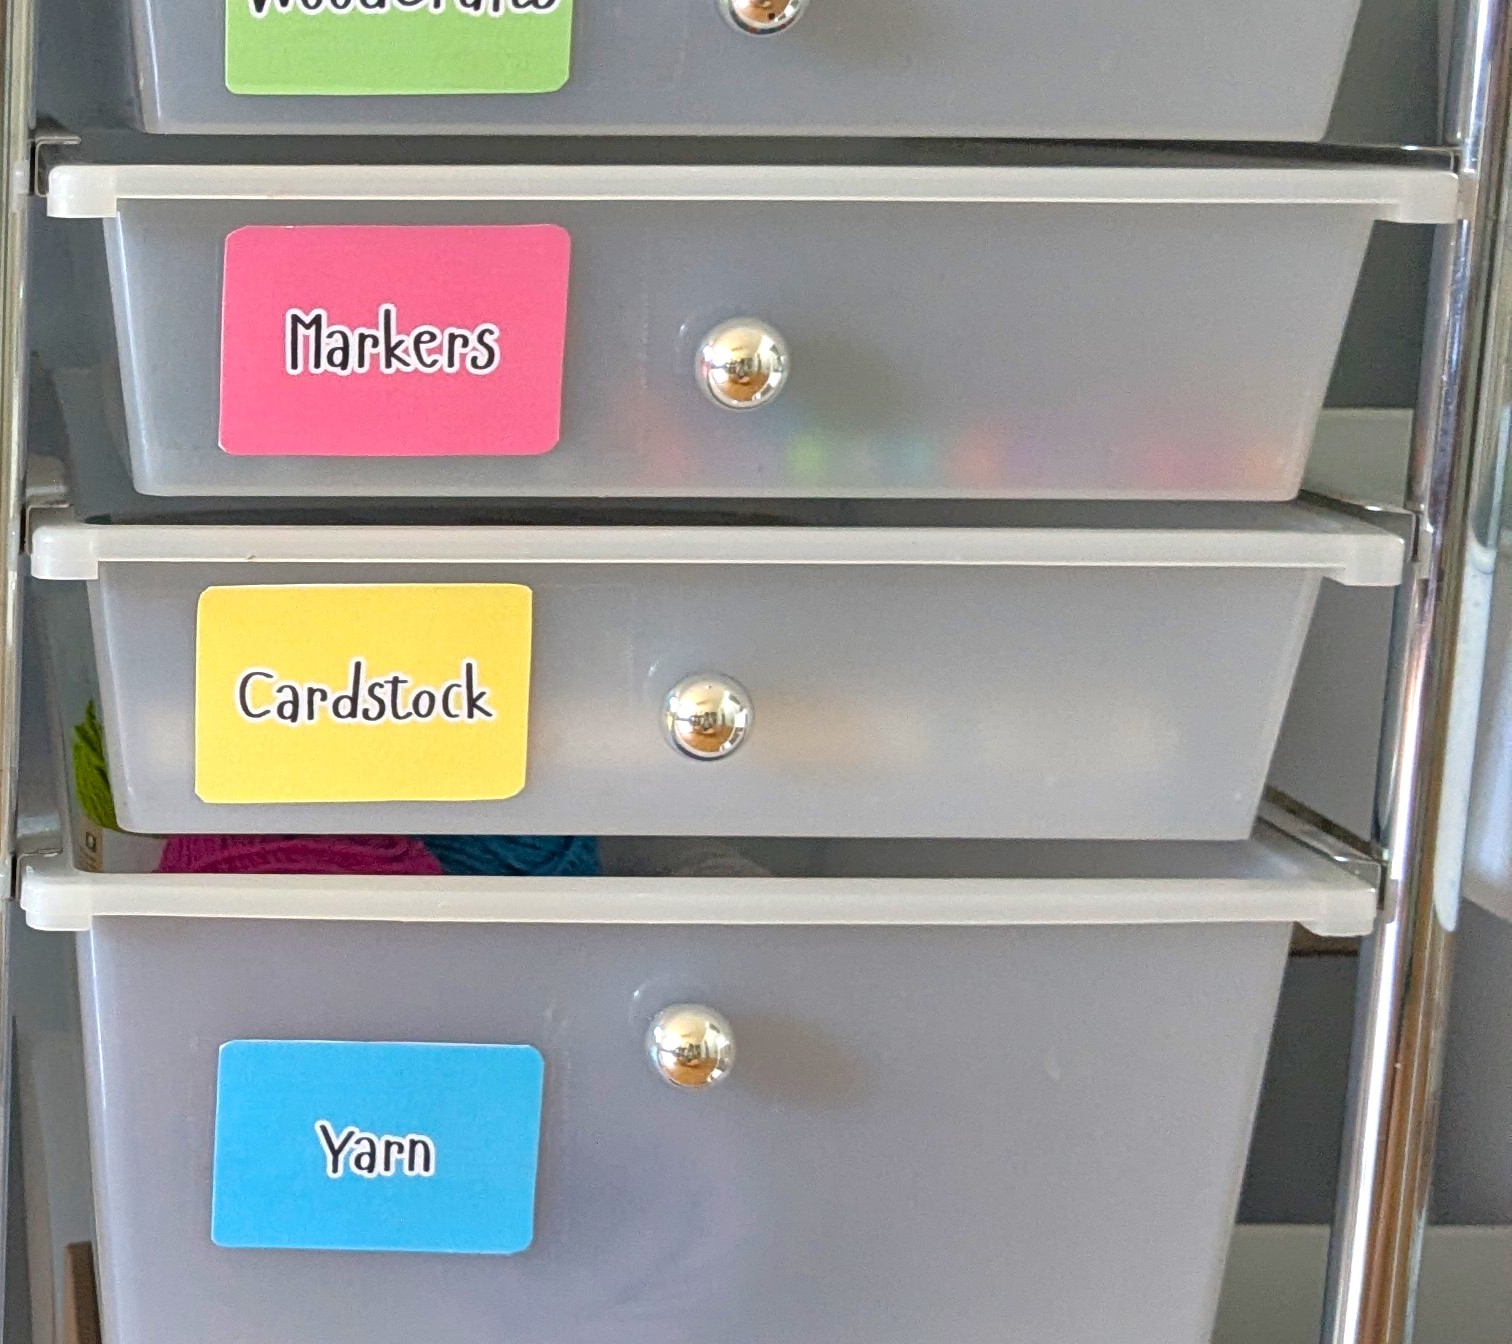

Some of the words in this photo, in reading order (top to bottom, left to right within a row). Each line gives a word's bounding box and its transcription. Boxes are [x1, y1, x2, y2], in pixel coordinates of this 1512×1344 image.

[289, 307, 497, 372] Markers
[238, 660, 494, 724] Cardstock
[318, 1123, 433, 1175] Yarn
